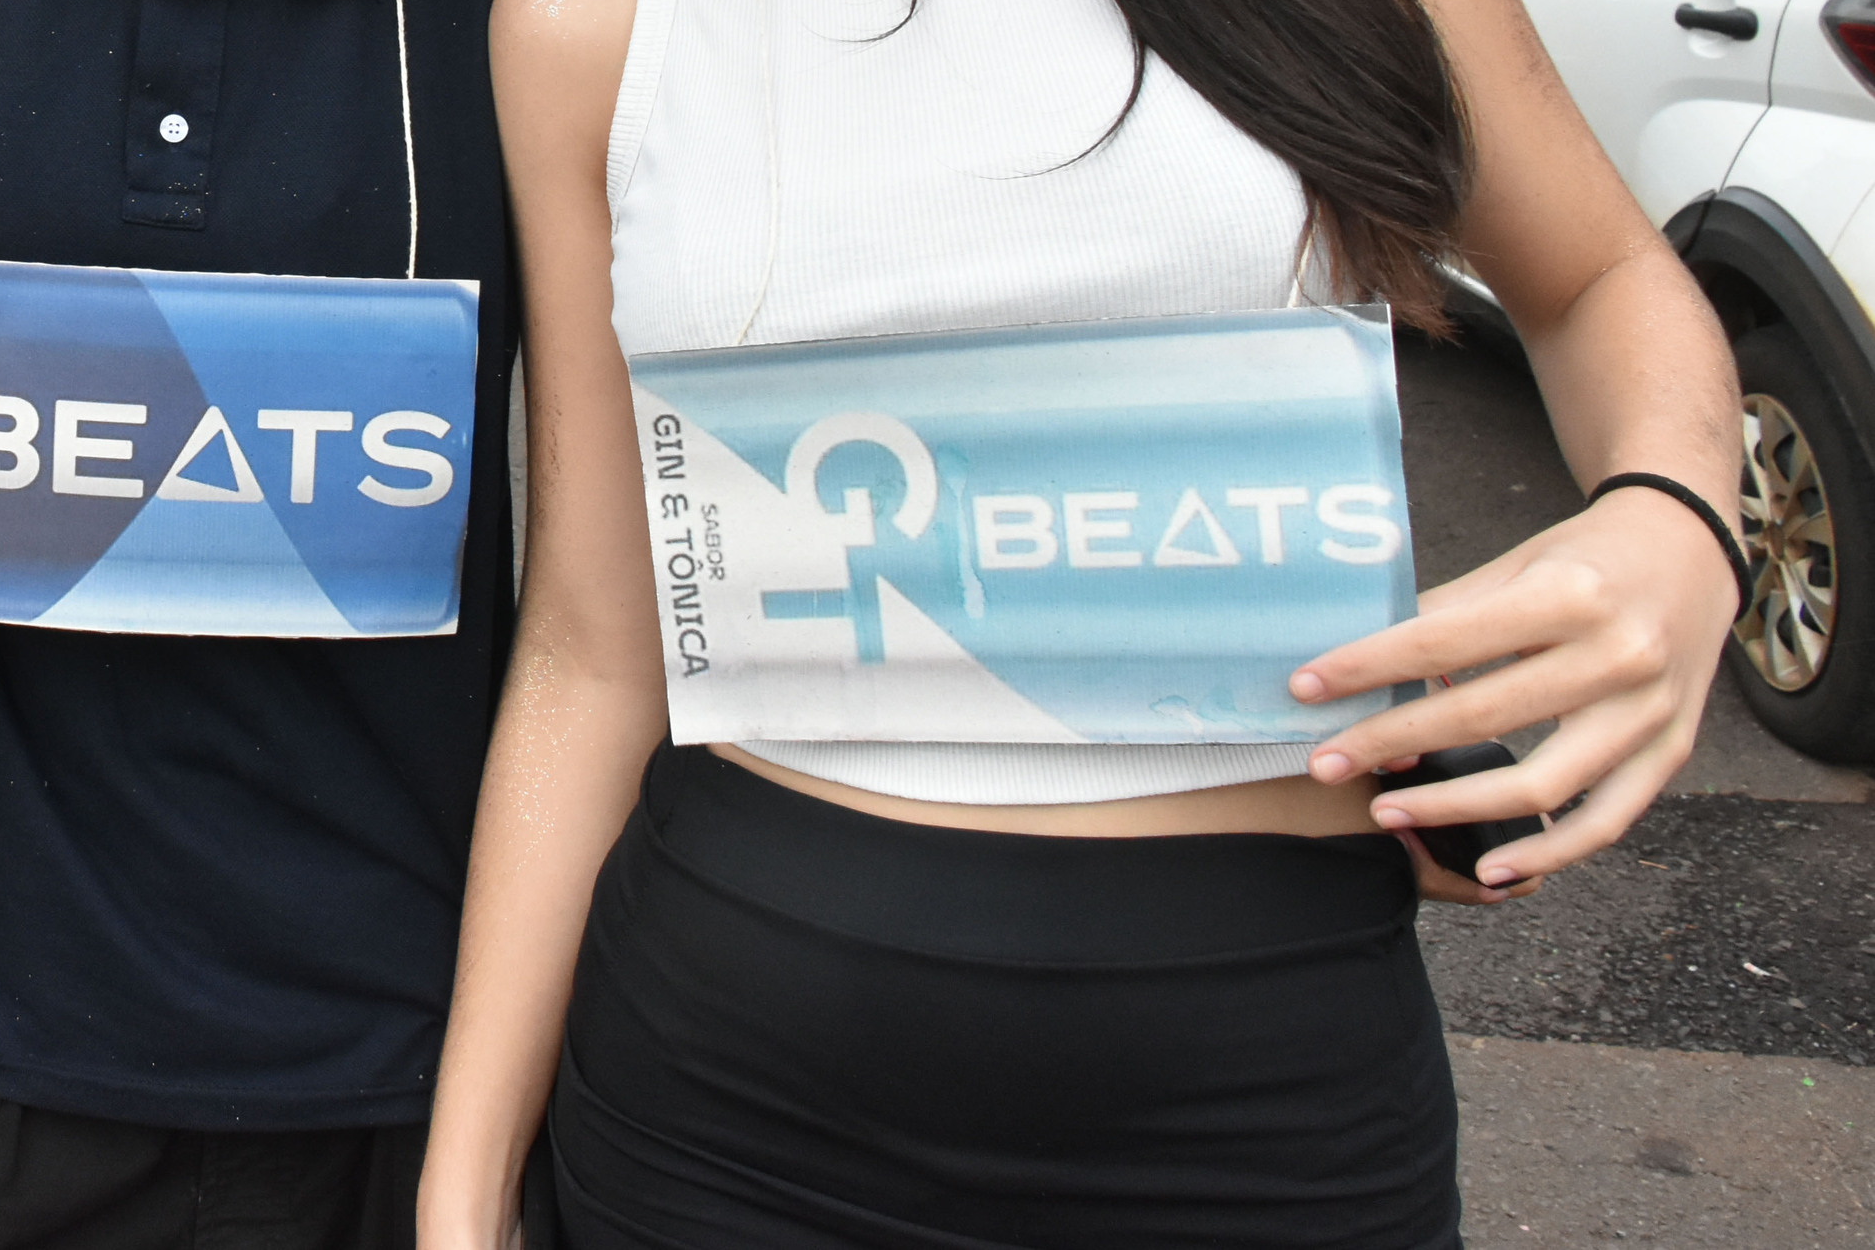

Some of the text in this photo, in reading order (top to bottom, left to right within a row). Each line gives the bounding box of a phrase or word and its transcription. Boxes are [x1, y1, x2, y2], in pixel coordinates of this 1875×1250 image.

[652, 413, 686, 480] GIN
[701, 503, 725, 581] SABOR
[971, 482, 1403, 569] BEATS
[665, 527, 710, 678] TÔNICA
